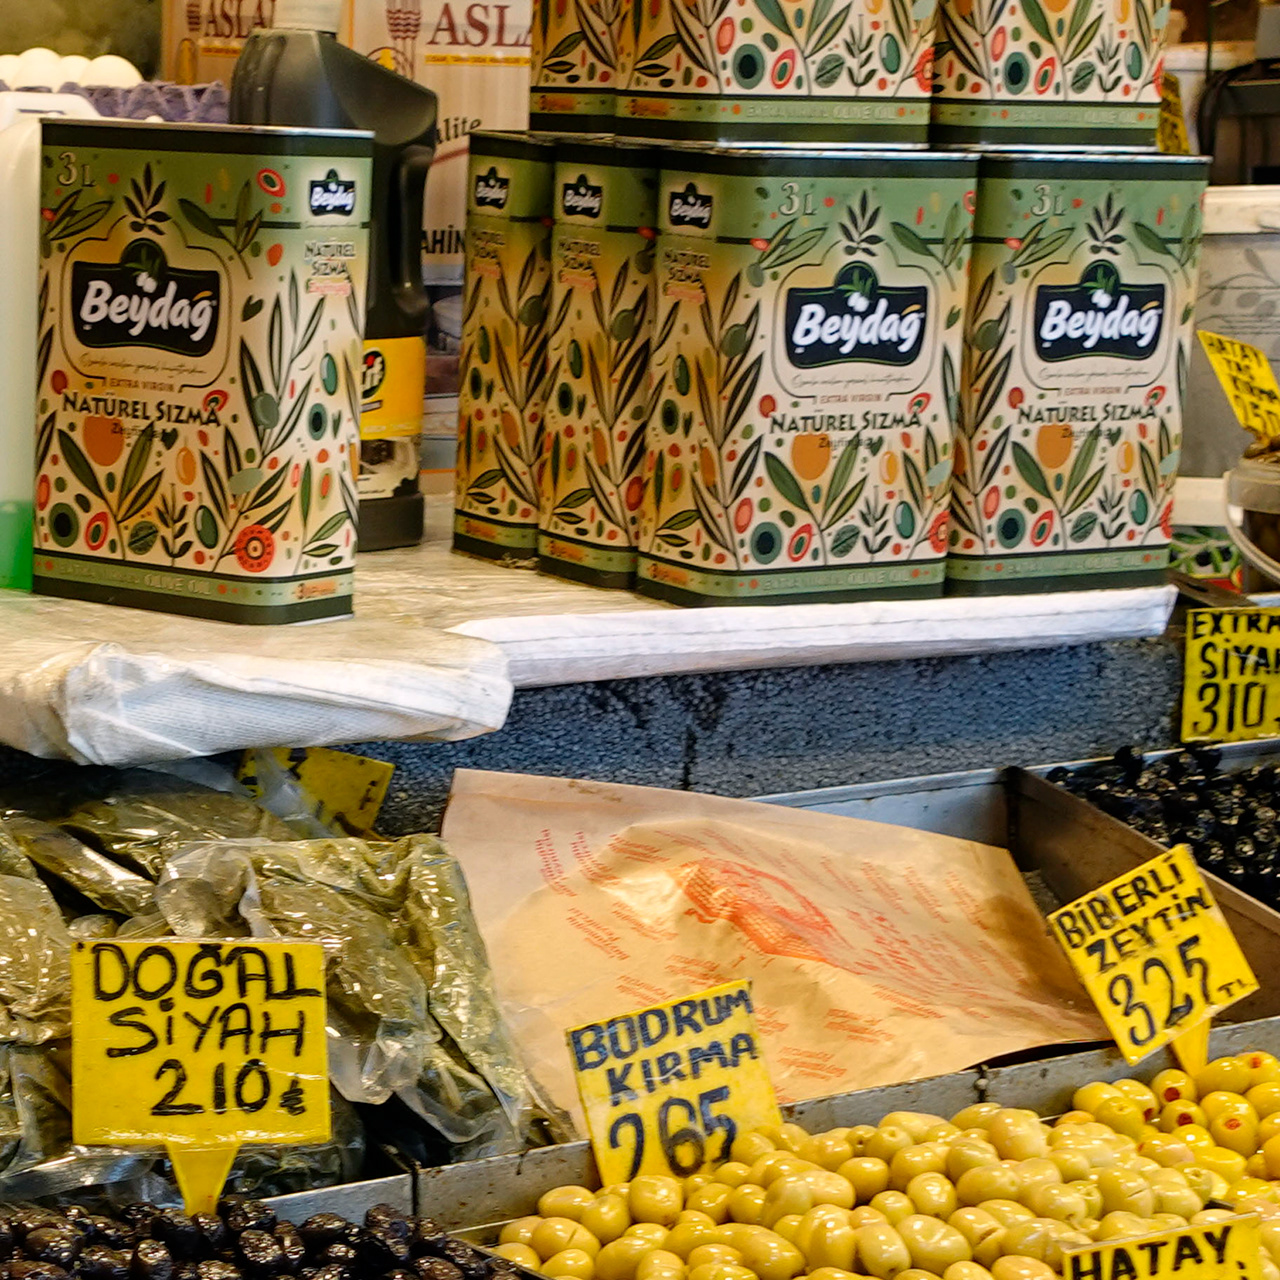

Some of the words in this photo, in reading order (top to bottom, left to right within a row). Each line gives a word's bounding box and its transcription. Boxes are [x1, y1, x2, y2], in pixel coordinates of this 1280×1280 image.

[204, 0, 275, 38] ASLA
[427, 3, 531, 47] ASL
[80, 279, 217, 342] Beydağ
[792, 298, 923, 354] Beydağ
[1040, 294, 1162, 348] Beydağ
[156, 400, 222, 427] SIZMA
[1193, 682, 1267, 734] 310
[1055, 855, 1185, 949] BİBERLİ
[1085, 887, 1214, 974] ZEYTİN
[91, 943, 323, 1001] DOĞAL
[1108, 935, 1216, 1047] 325
[106, 997, 305, 1057] SİYAH
[571, 989, 754, 1072] BODRUM
[606, 1033, 759, 1106] KIRMA
[609, 1085, 737, 1183] 265
